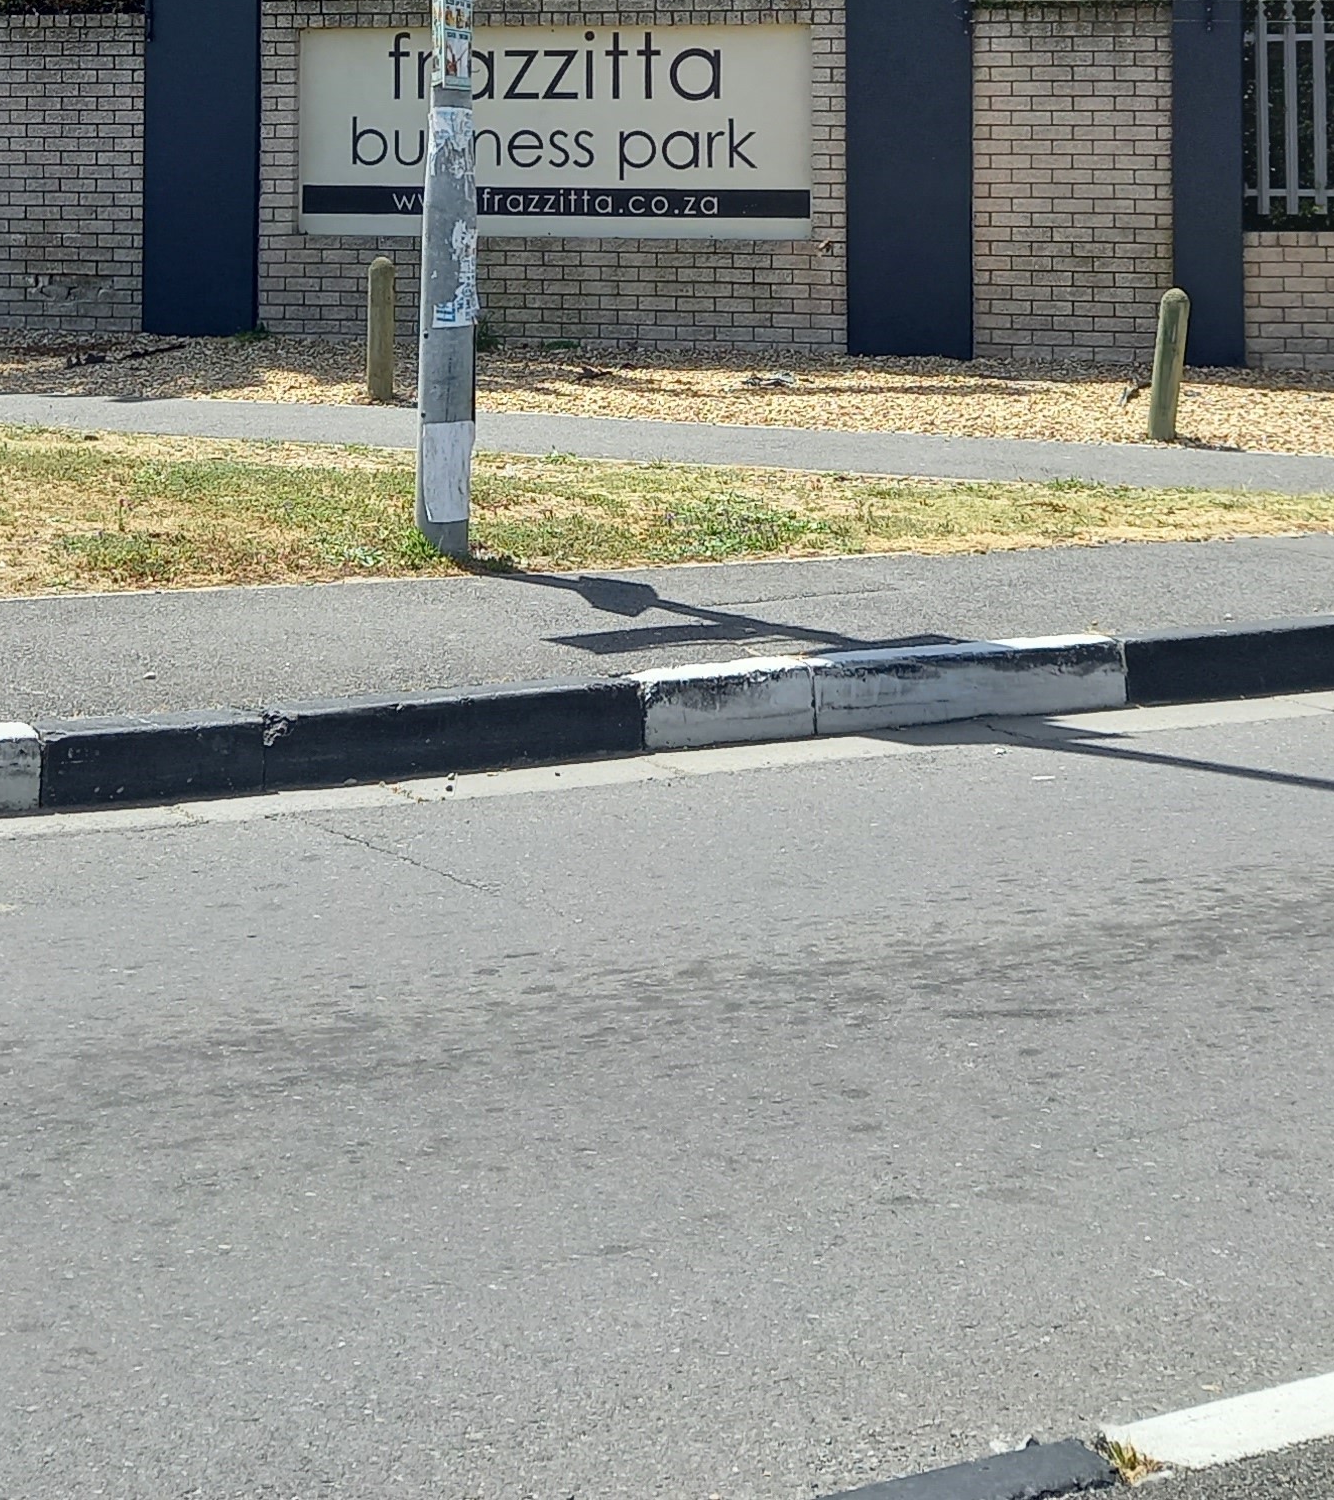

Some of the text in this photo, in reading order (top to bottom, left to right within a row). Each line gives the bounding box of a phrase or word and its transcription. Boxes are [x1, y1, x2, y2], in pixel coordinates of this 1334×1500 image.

[351, 116, 595, 169] buness
[619, 118, 757, 181] park
[392, 189, 719, 215] wfrazzitta.co.za
